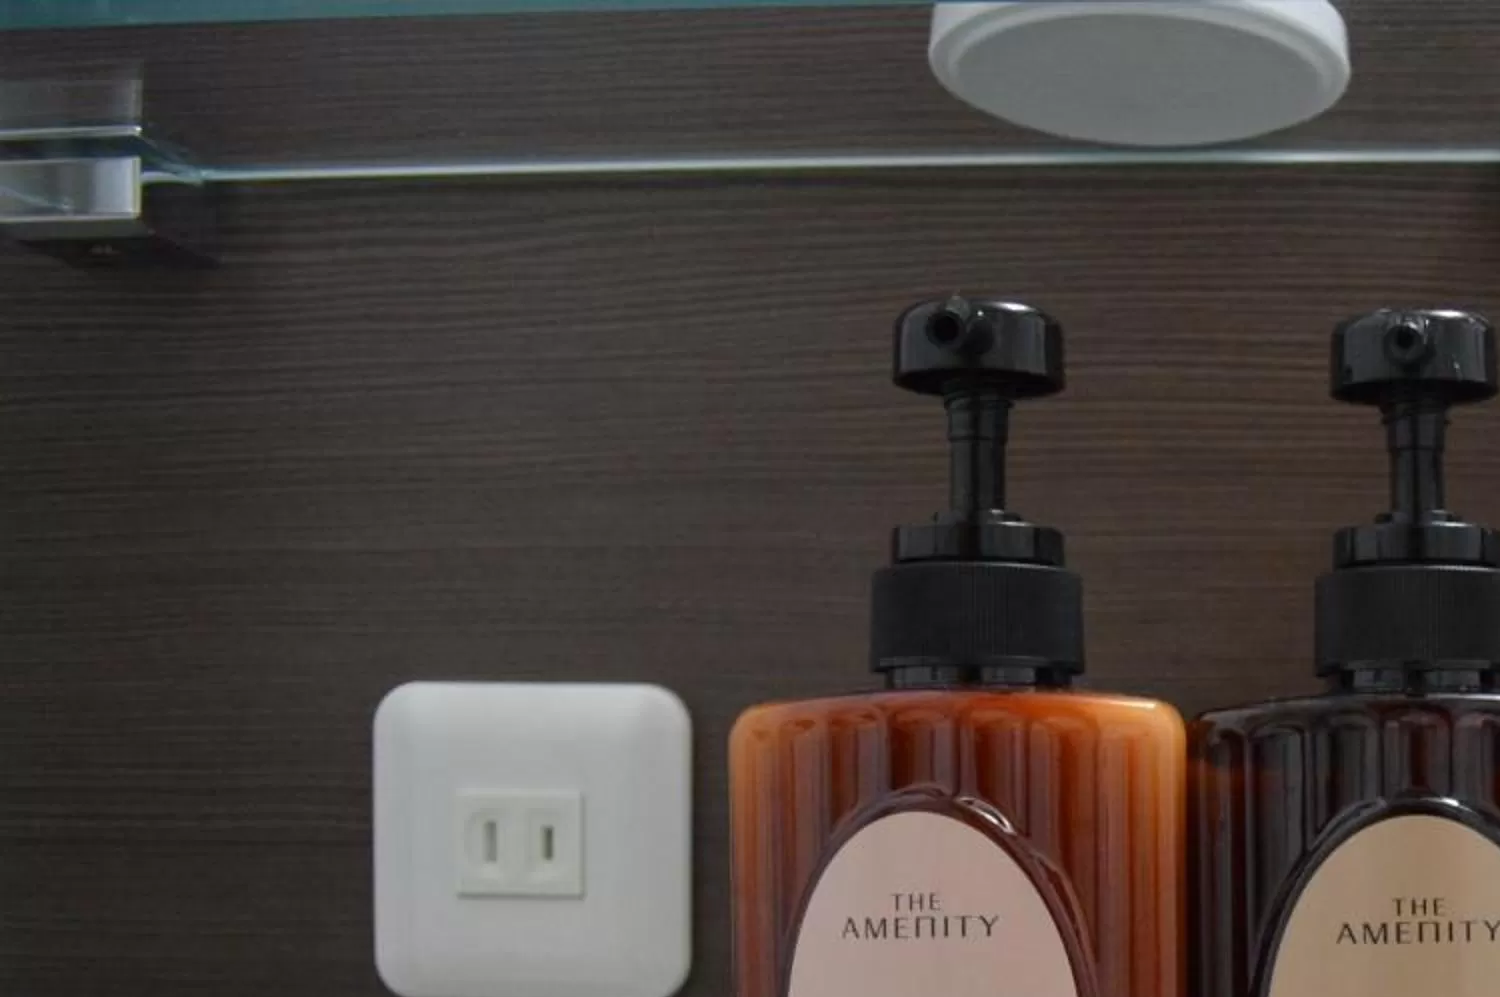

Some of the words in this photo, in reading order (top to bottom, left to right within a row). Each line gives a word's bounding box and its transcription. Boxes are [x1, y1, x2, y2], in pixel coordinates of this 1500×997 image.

[891, 892, 941, 911] THE
[1393, 897, 1446, 917] THE
[842, 914, 999, 940] AMENITY
